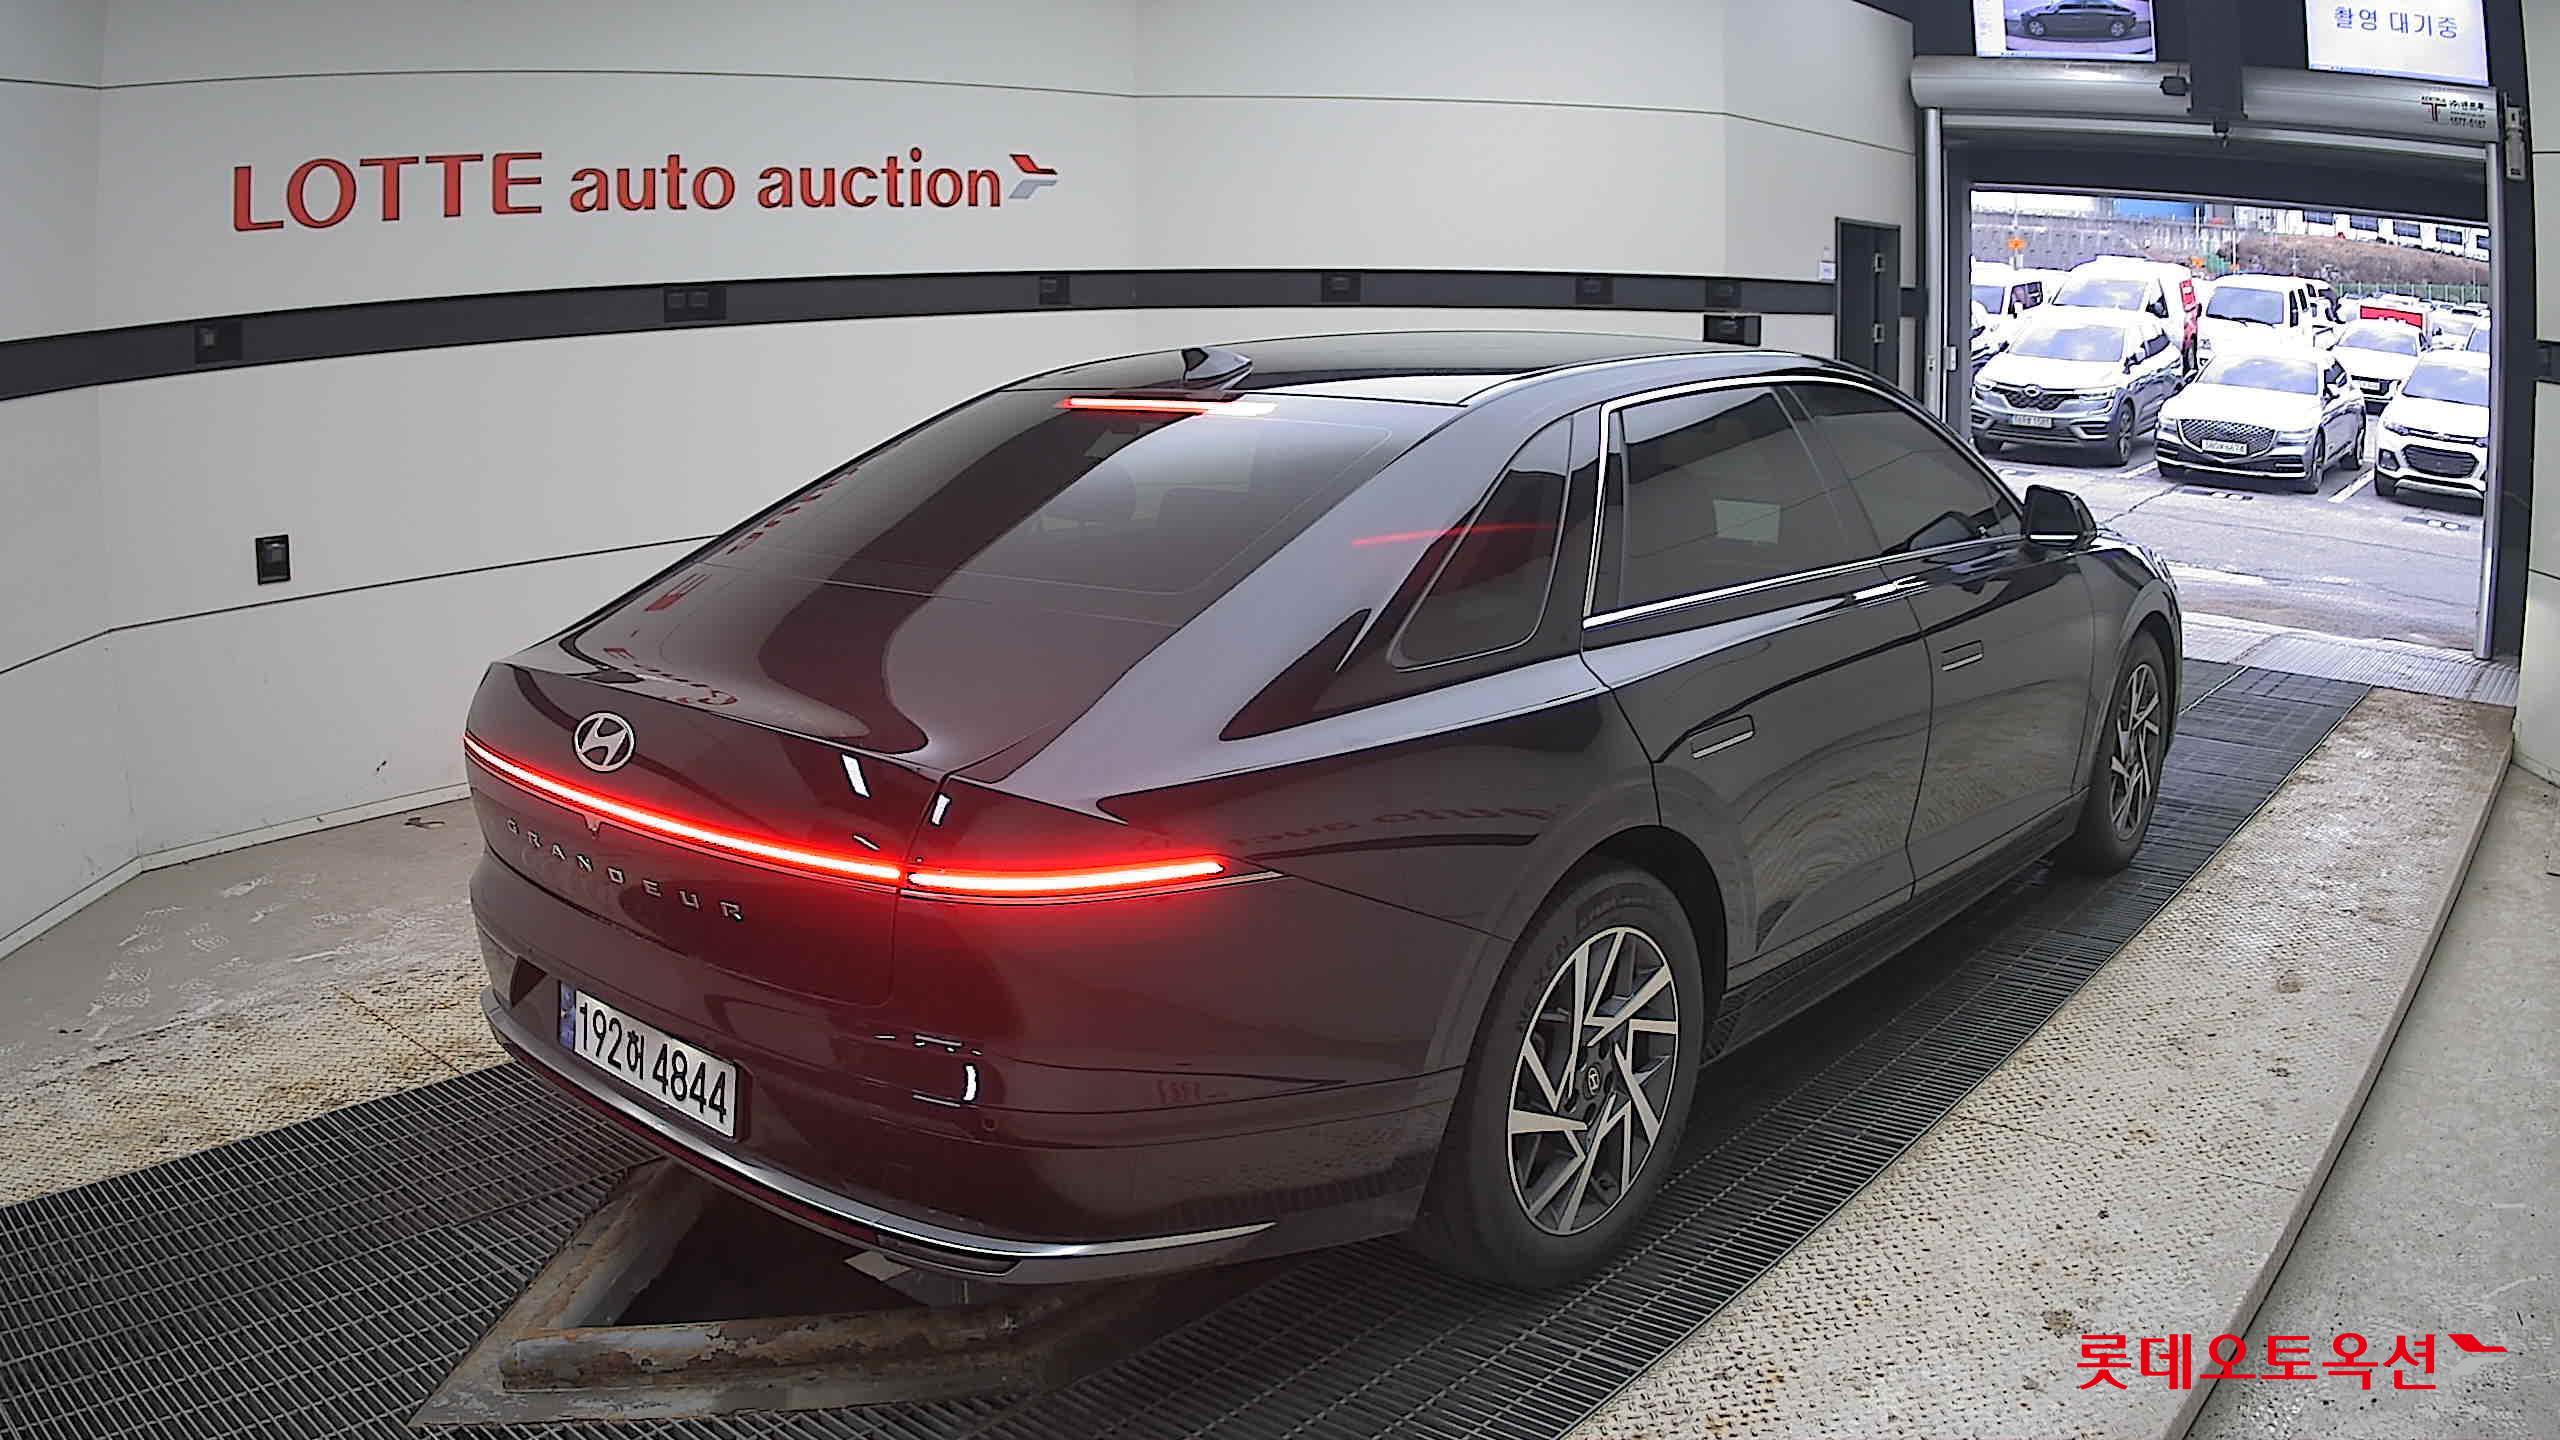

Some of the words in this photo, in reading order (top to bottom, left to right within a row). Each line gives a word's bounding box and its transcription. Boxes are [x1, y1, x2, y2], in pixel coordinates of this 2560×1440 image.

[2335, 6, 2378, 31] 촬영
[2390, 12, 2458, 39] 대기중
[234, 151, 543, 231] LOTTE
[570, 154, 736, 212] auto
[757, 147, 1003, 208] auction
[505, 817, 744, 920] GRANDEUR
[580, 1002, 645, 1080] 192허
[653, 1043, 727, 1124] 4844
